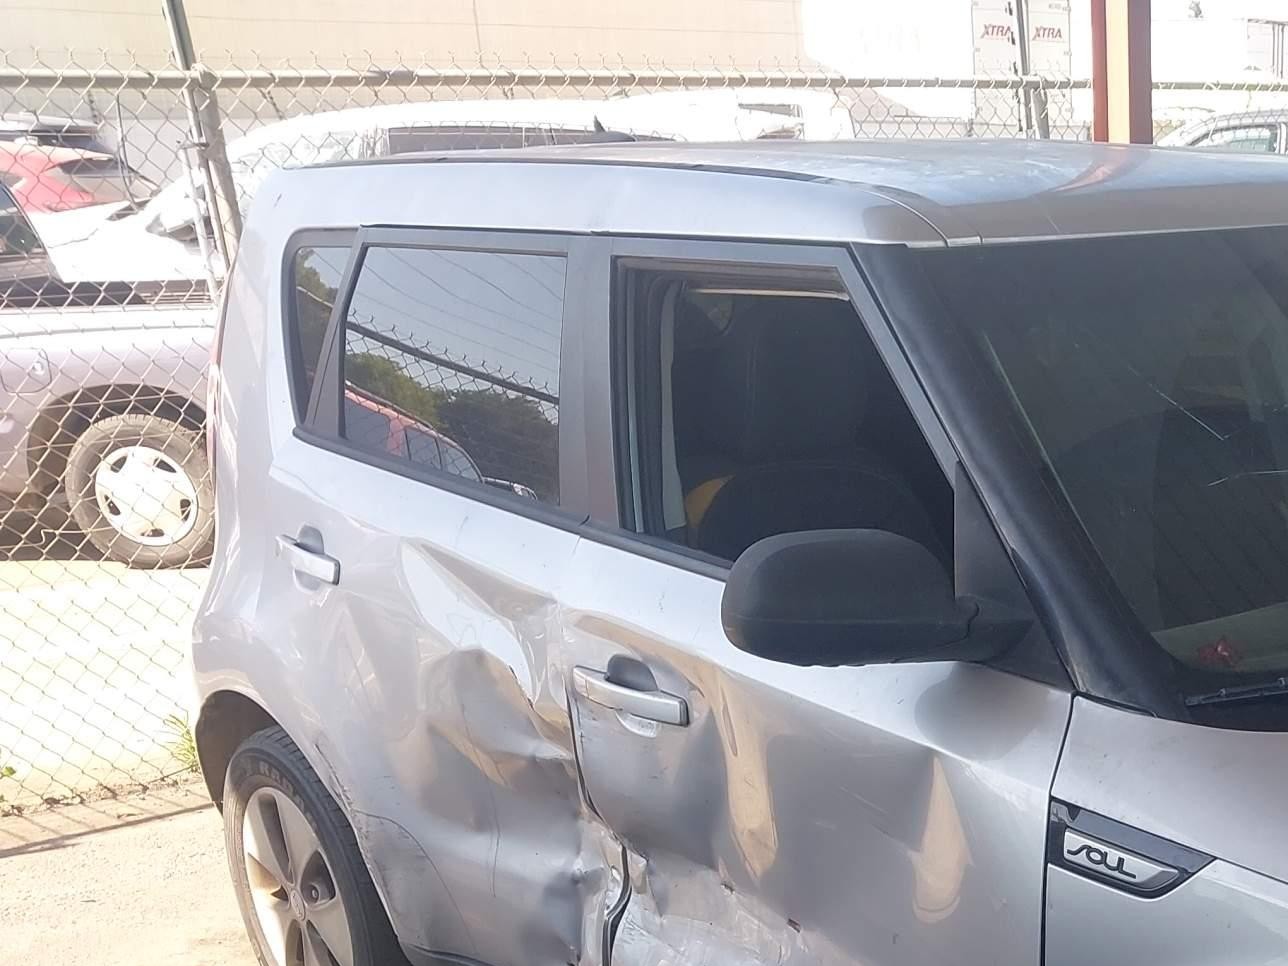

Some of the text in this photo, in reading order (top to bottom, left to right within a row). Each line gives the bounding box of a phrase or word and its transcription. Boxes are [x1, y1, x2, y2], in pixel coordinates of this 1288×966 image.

[980, 23, 1011, 39] XTRA
[1031, 25, 1063, 41] XTRA
[1066, 844, 1136, 880] SOUL
